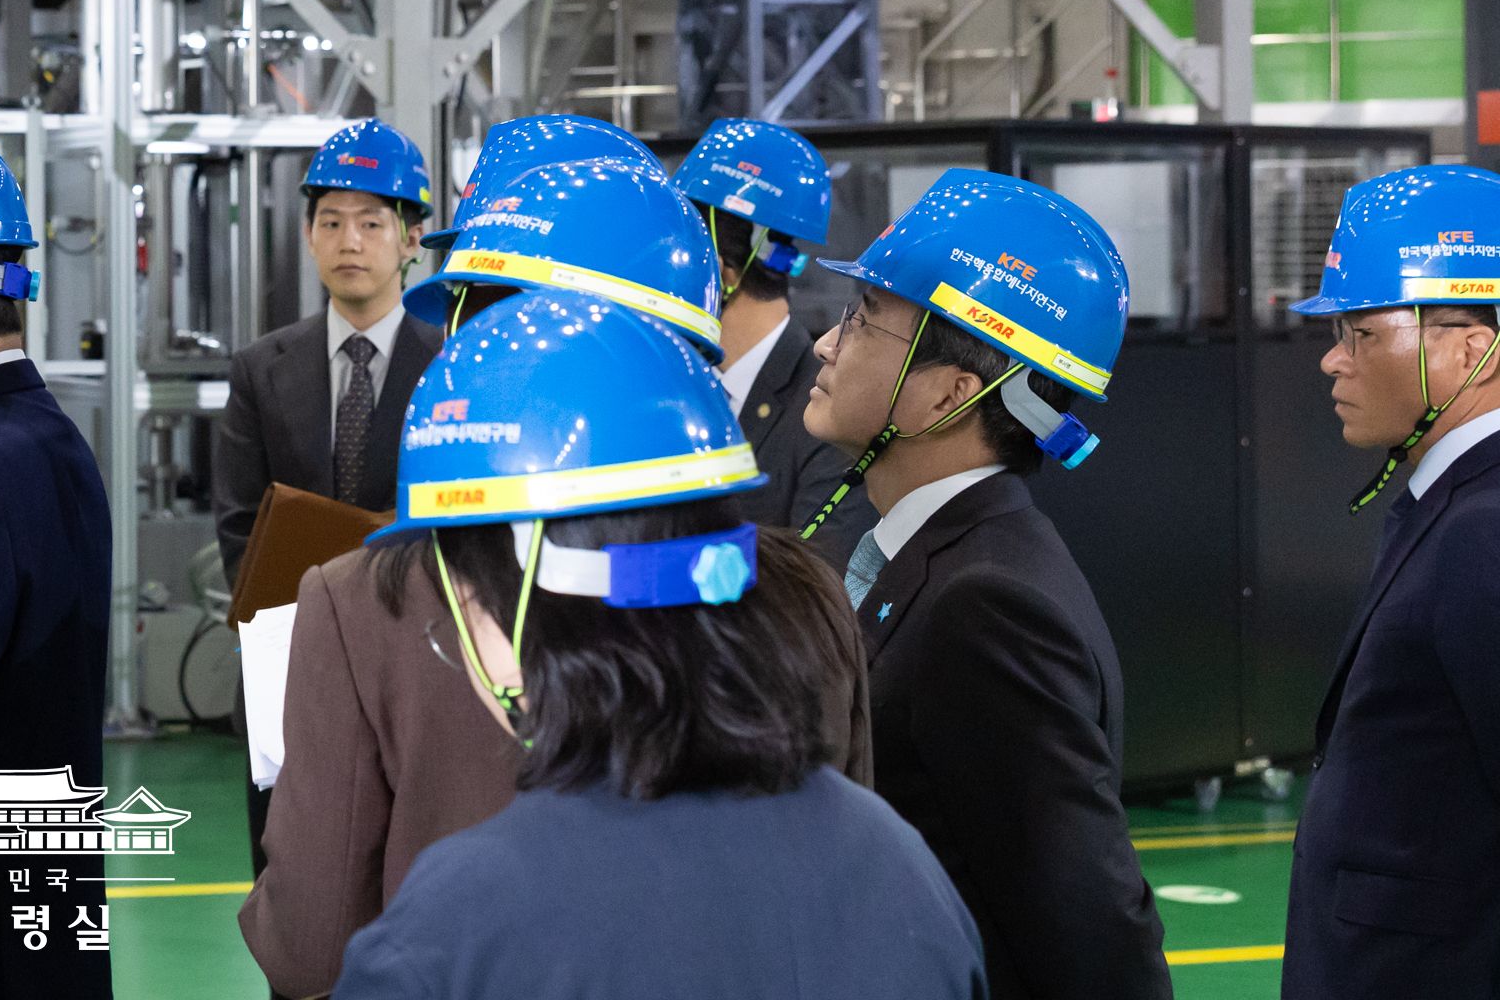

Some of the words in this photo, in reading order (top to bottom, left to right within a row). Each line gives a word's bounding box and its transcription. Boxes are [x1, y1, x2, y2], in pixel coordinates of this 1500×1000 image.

[1438, 230, 1474, 244] KFE
[466, 256, 506, 271] KSTAR
[996, 251, 1039, 282] KFE
[949, 247, 1068, 322] 한국핵융합에너지연구원
[1450, 283, 1495, 295] KSTAR
[966, 305, 1016, 340] KSTAR
